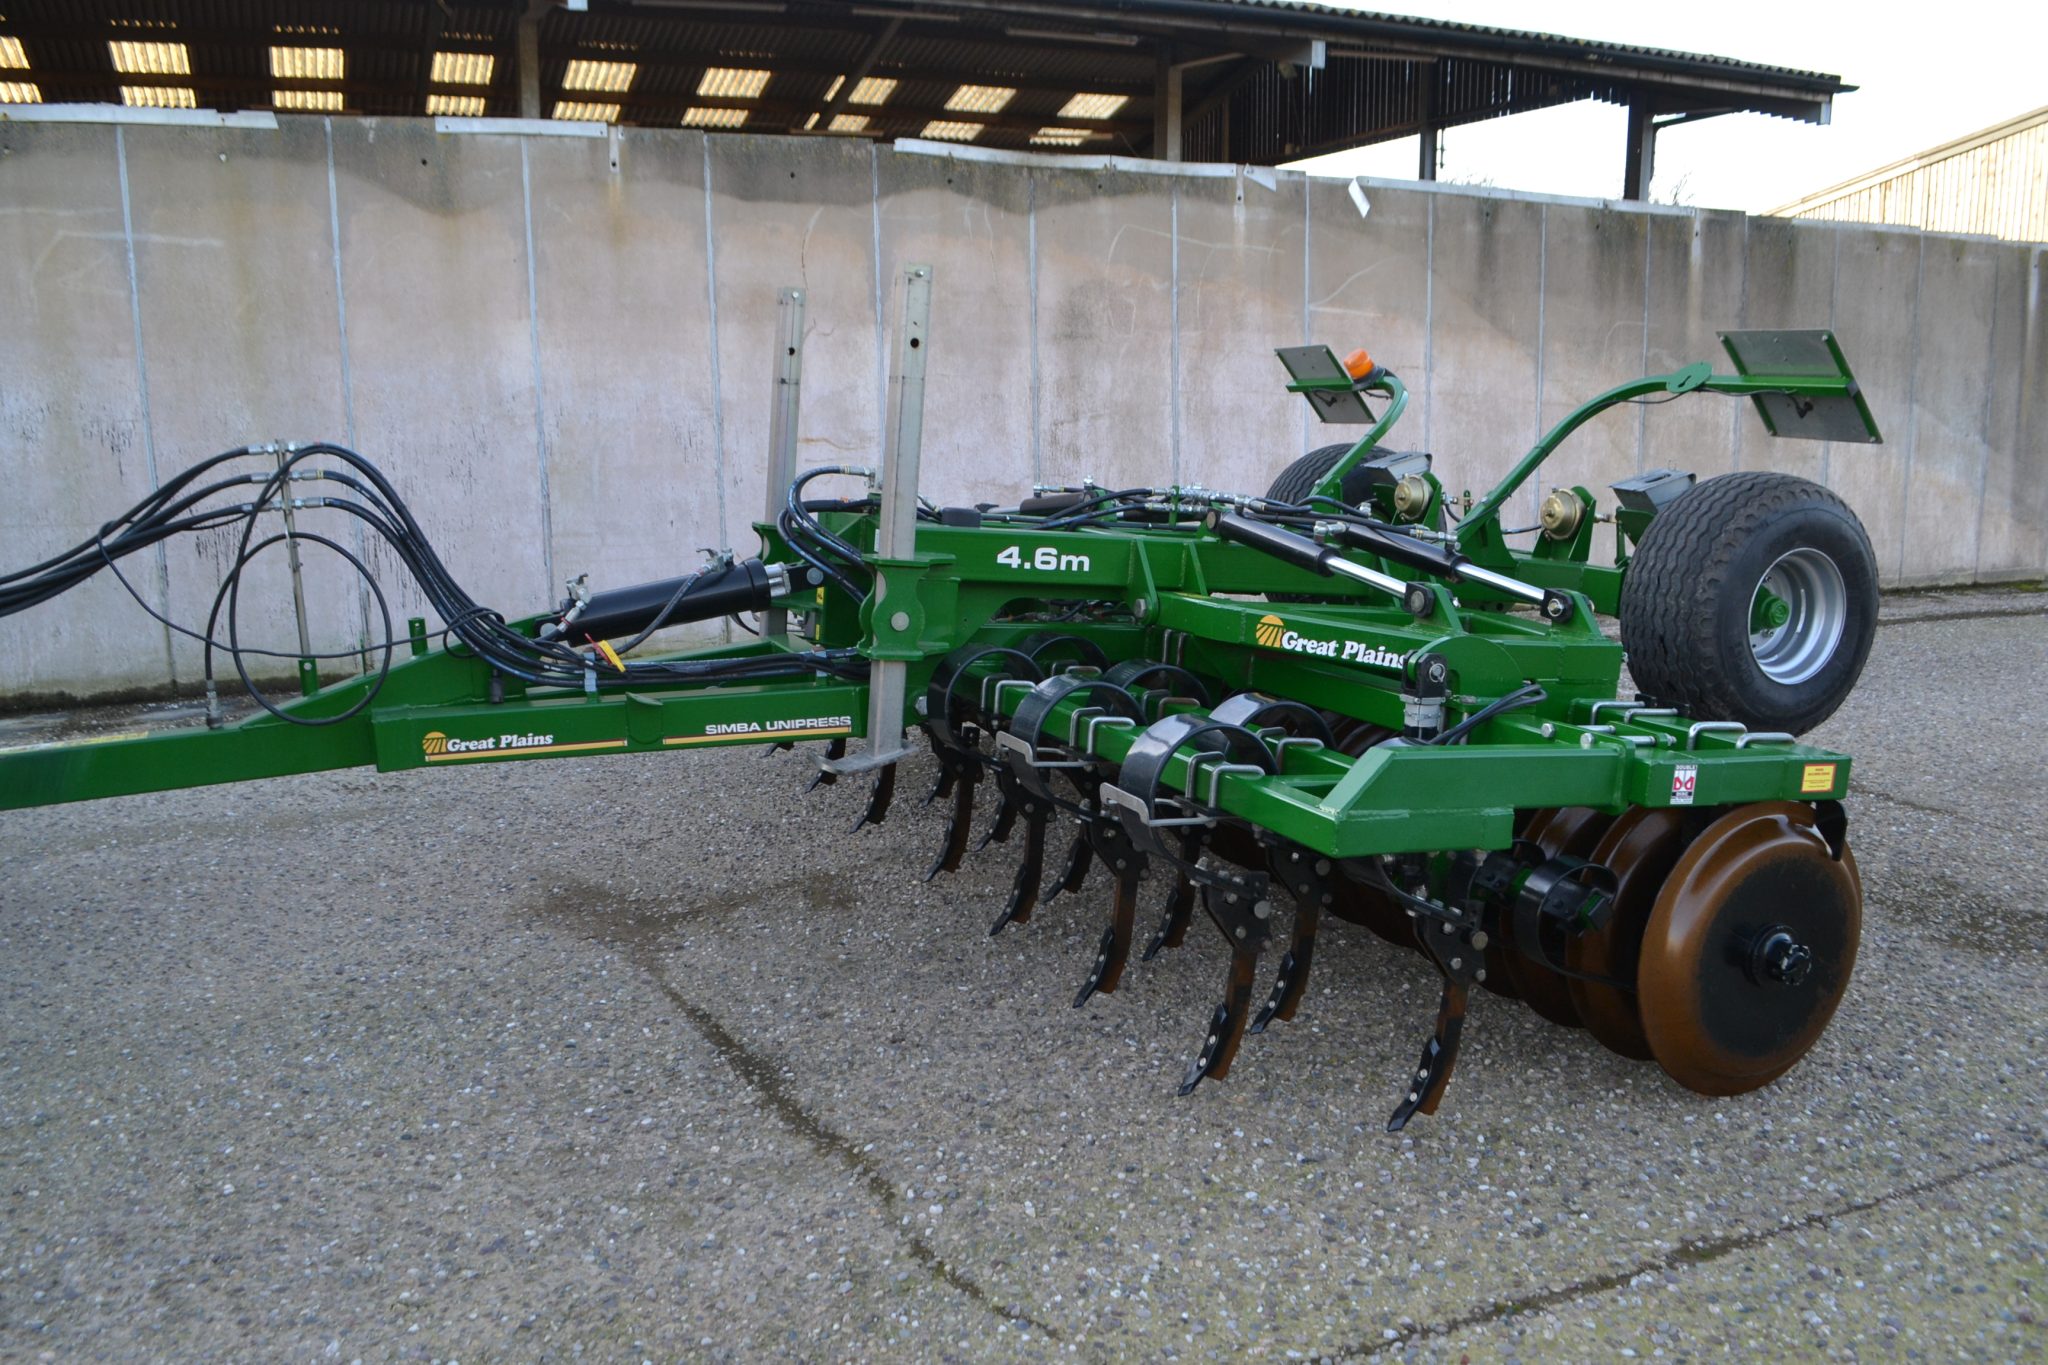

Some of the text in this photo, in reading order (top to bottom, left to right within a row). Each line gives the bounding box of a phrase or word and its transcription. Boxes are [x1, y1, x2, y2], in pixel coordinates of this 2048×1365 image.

[997, 545, 1090, 572] 4.6m
[1281, 630, 1405, 670] Great Plains
[705, 715, 851, 735] SIMBA UNIPRESS
[447, 731, 554, 754] Great Plains
